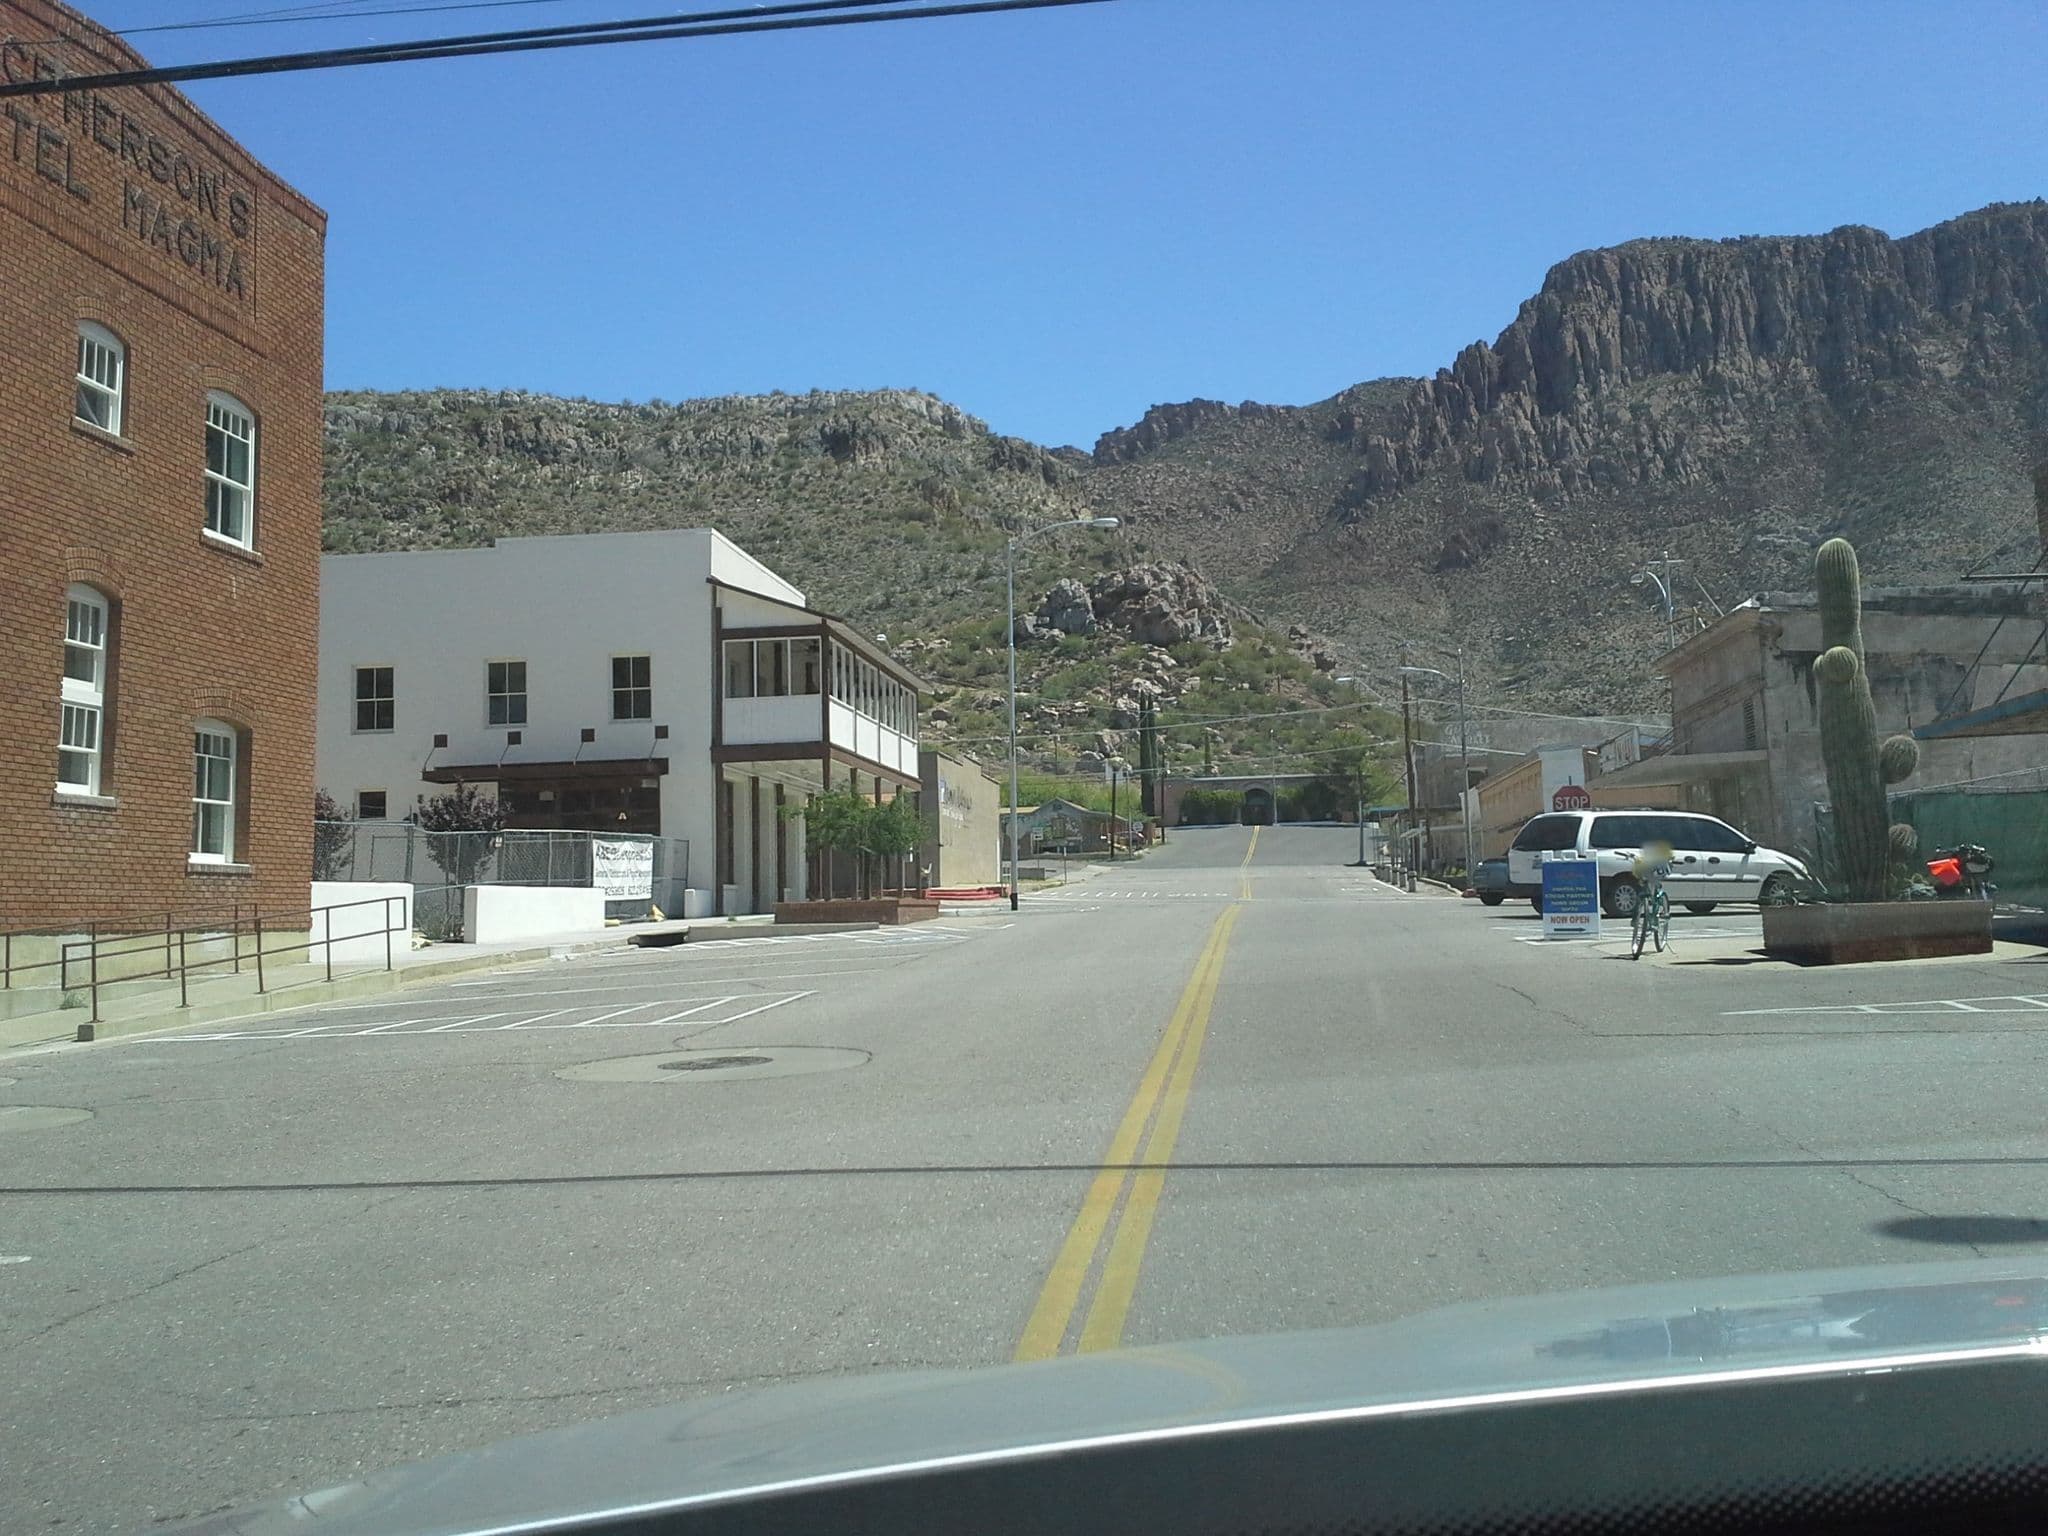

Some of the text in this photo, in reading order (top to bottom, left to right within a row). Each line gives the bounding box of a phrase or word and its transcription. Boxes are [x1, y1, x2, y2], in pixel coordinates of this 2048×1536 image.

[123, 176, 244, 301] MAGMA
[1555, 796, 1589, 811] STOP
[1550, 915, 1590, 924] NOW OPEN
